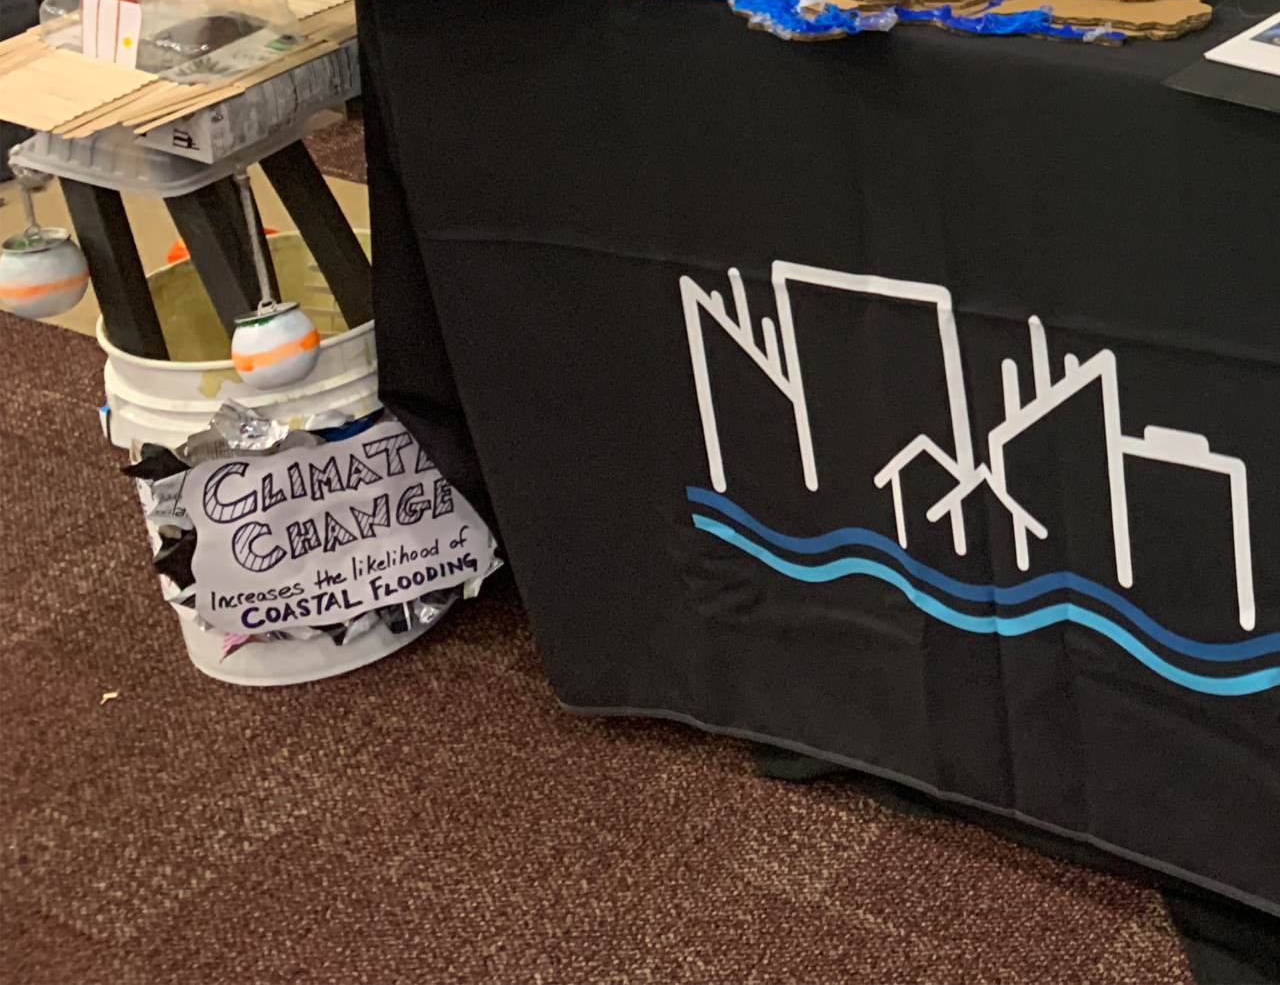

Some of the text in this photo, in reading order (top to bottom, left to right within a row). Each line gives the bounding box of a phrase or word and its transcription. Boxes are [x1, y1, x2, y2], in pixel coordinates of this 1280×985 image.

[211, 525, 469, 611] Increases the likelihood of
[231, 477, 454, 573] CHANGE
[241, 552, 478, 630] COASTAL FLOODING
